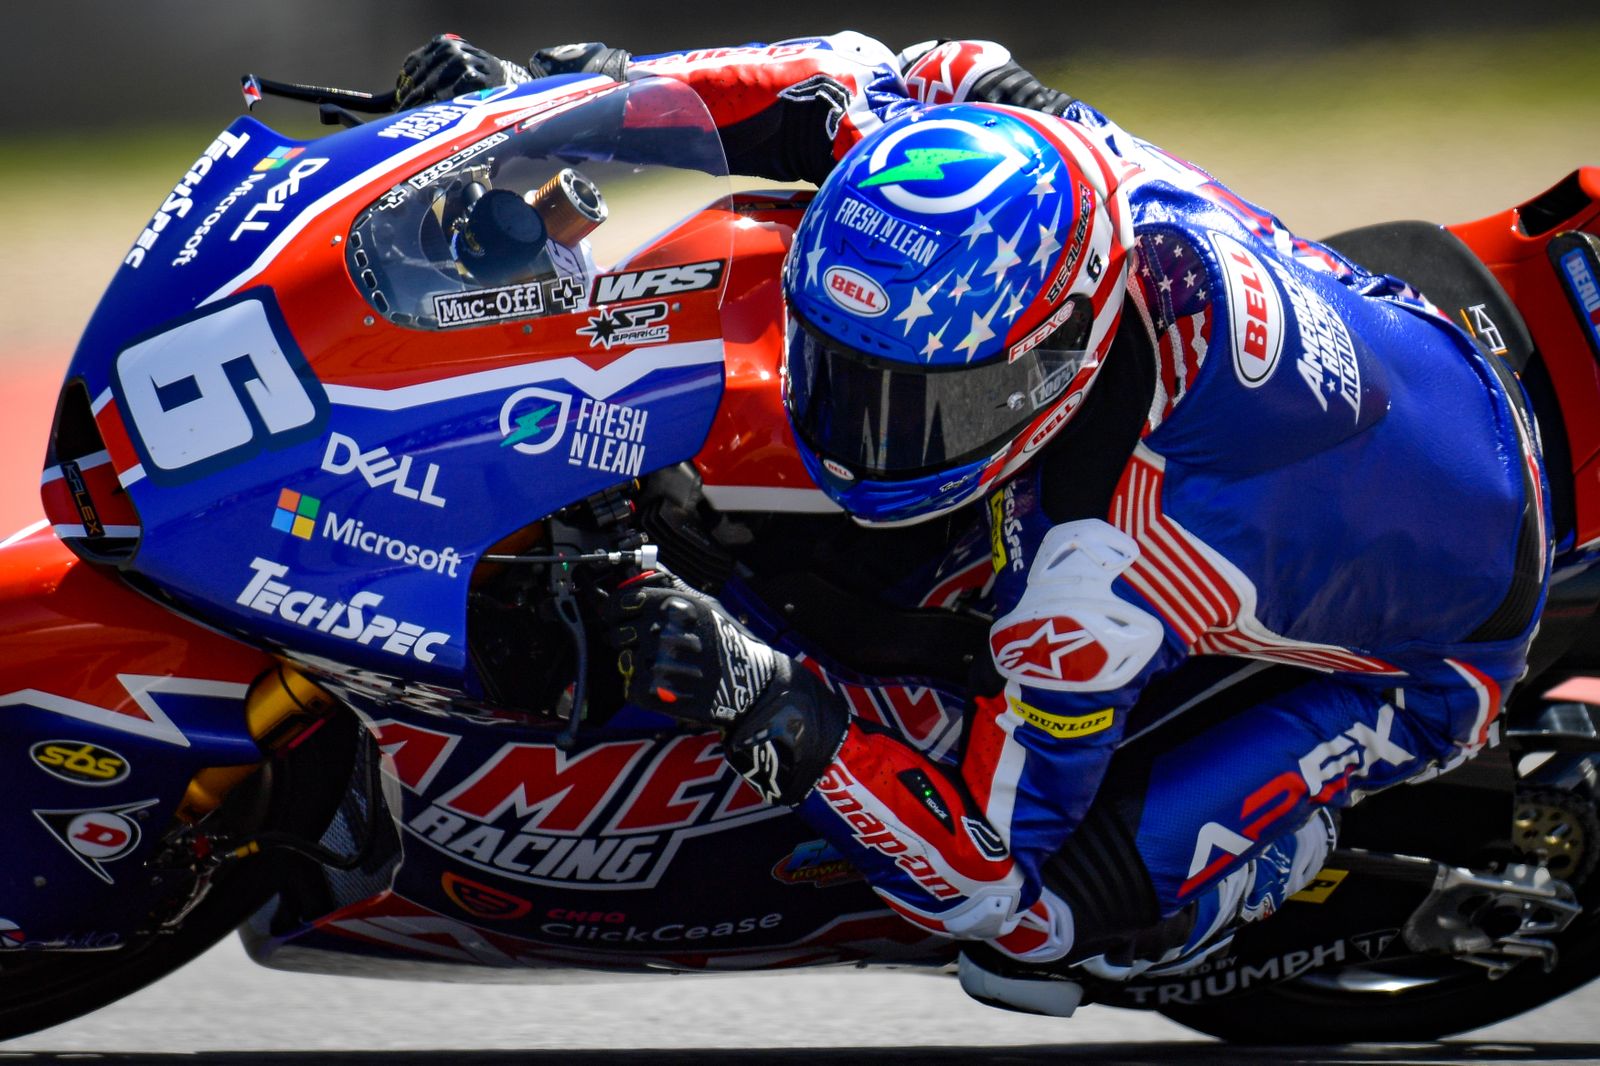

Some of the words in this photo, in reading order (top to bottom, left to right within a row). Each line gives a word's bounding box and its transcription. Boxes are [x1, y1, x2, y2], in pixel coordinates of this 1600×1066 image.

[172, 173, 266, 267] Microsoft
[229, 158, 330, 241] DELL
[834, 198, 880, 236] FRESH
[878, 223, 894, 243] N
[890, 226, 940, 267] LEAN
[596, 262, 720, 303] WRS
[831, 274, 878, 309] BELL
[1086, 248, 1102, 283] 6
[441, 285, 539, 323] Muc-Off
[611, 303, 667, 328] SP
[1231, 251, 1269, 361] BELL
[1301, 284, 1341, 377] RACI
[1261, 253, 1328, 412] AMERICAN
[116, 299, 317, 469] 6
[575, 398, 648, 443] FRESH
[1032, 403, 1076, 446] BELL
[320, 431, 446, 508] DELL
[568, 432, 588, 466] N
[588, 434, 646, 477] LEAN
[64, 464, 100, 533] KALEX
[322, 512, 462, 577] Microsoft
[1027, 711, 1108, 732] DUNLOP
[37, 744, 124, 779] sbs
[409, 804, 661, 882] RACING
[540, 913, 783, 942] ClickCease
[1125, 940, 1345, 1004] TRIUMPH
[1214, 956, 1238, 973] BY
